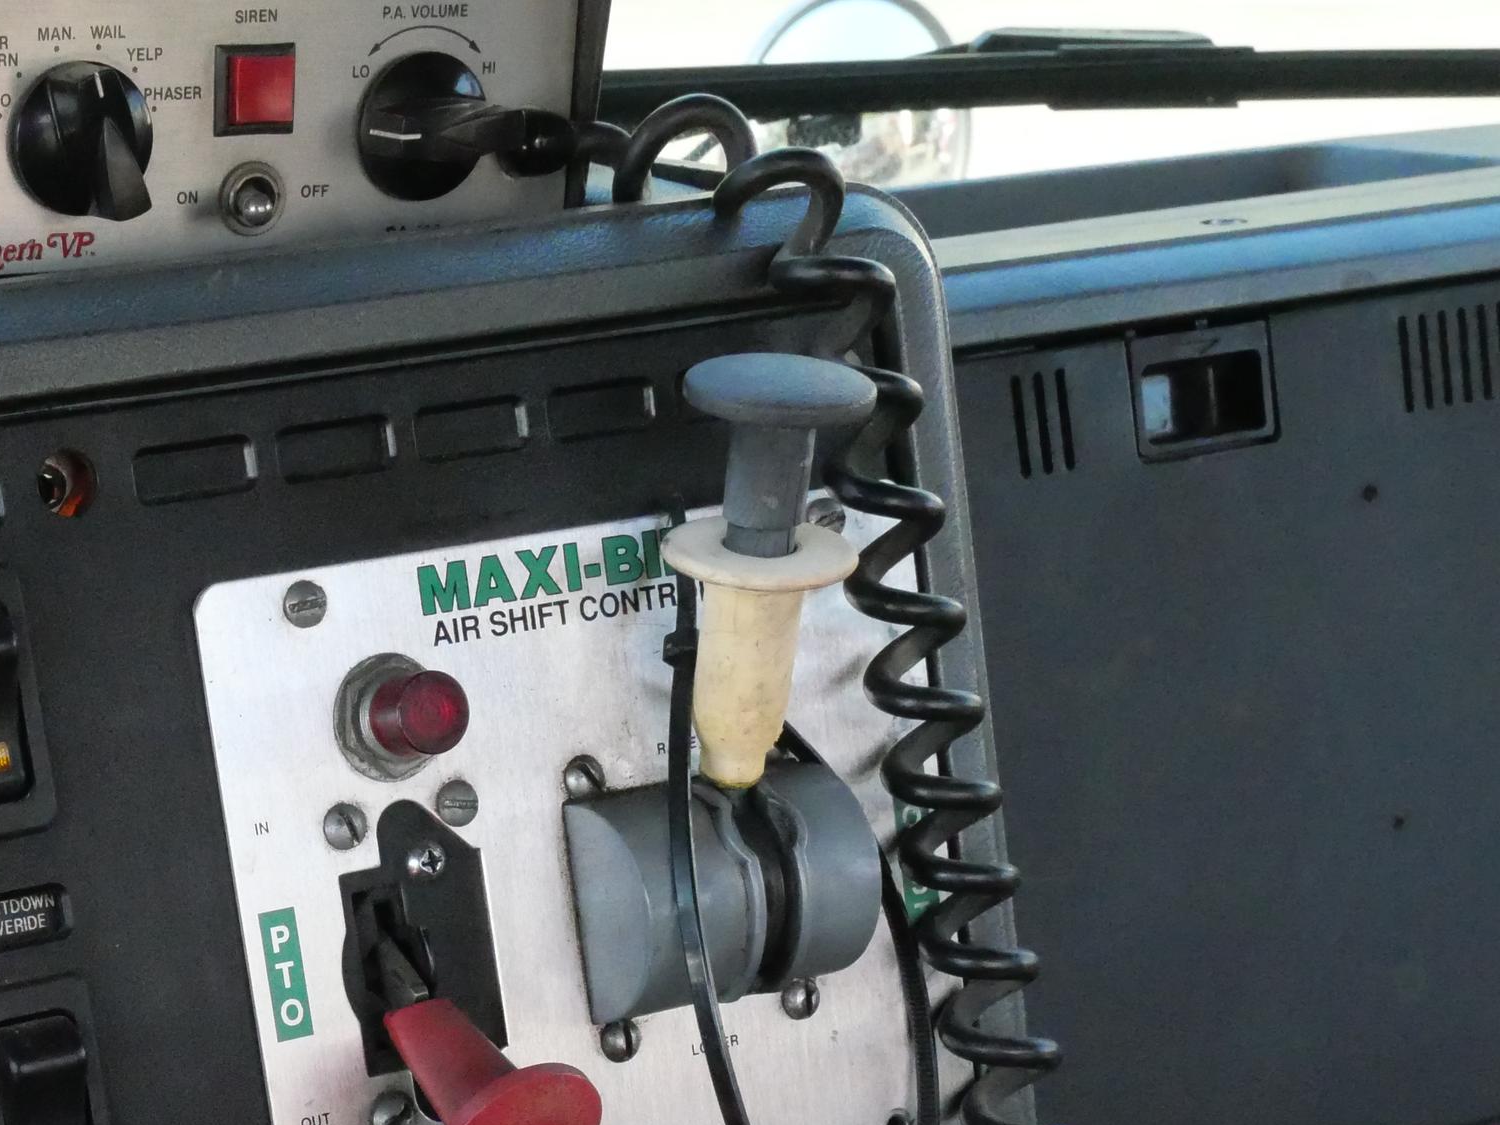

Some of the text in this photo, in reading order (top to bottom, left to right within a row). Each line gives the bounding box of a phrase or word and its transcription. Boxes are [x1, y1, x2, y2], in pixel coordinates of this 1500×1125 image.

[234, 9, 278, 24] SIREN
[382, 3, 470, 20] P.A. VOLUME
[37, 26, 76, 42] MAN.
[90, 25, 126, 40] WAIL
[126, 47, 163, 62] YELP
[352, 64, 371, 79] LO
[482, 61, 496, 76] HI
[143, 85, 202, 101] PHASER
[176, 191, 199, 205] ON
[300, 184, 330, 199] OFF
[46, 231, 96, 259] VP
[417, 526, 678, 616] MAXI-BI
[433, 581, 704, 647] AIR SHIFT CONTR
[254, 821, 270, 836] IN
[269, 924, 304, 1027] PTO
